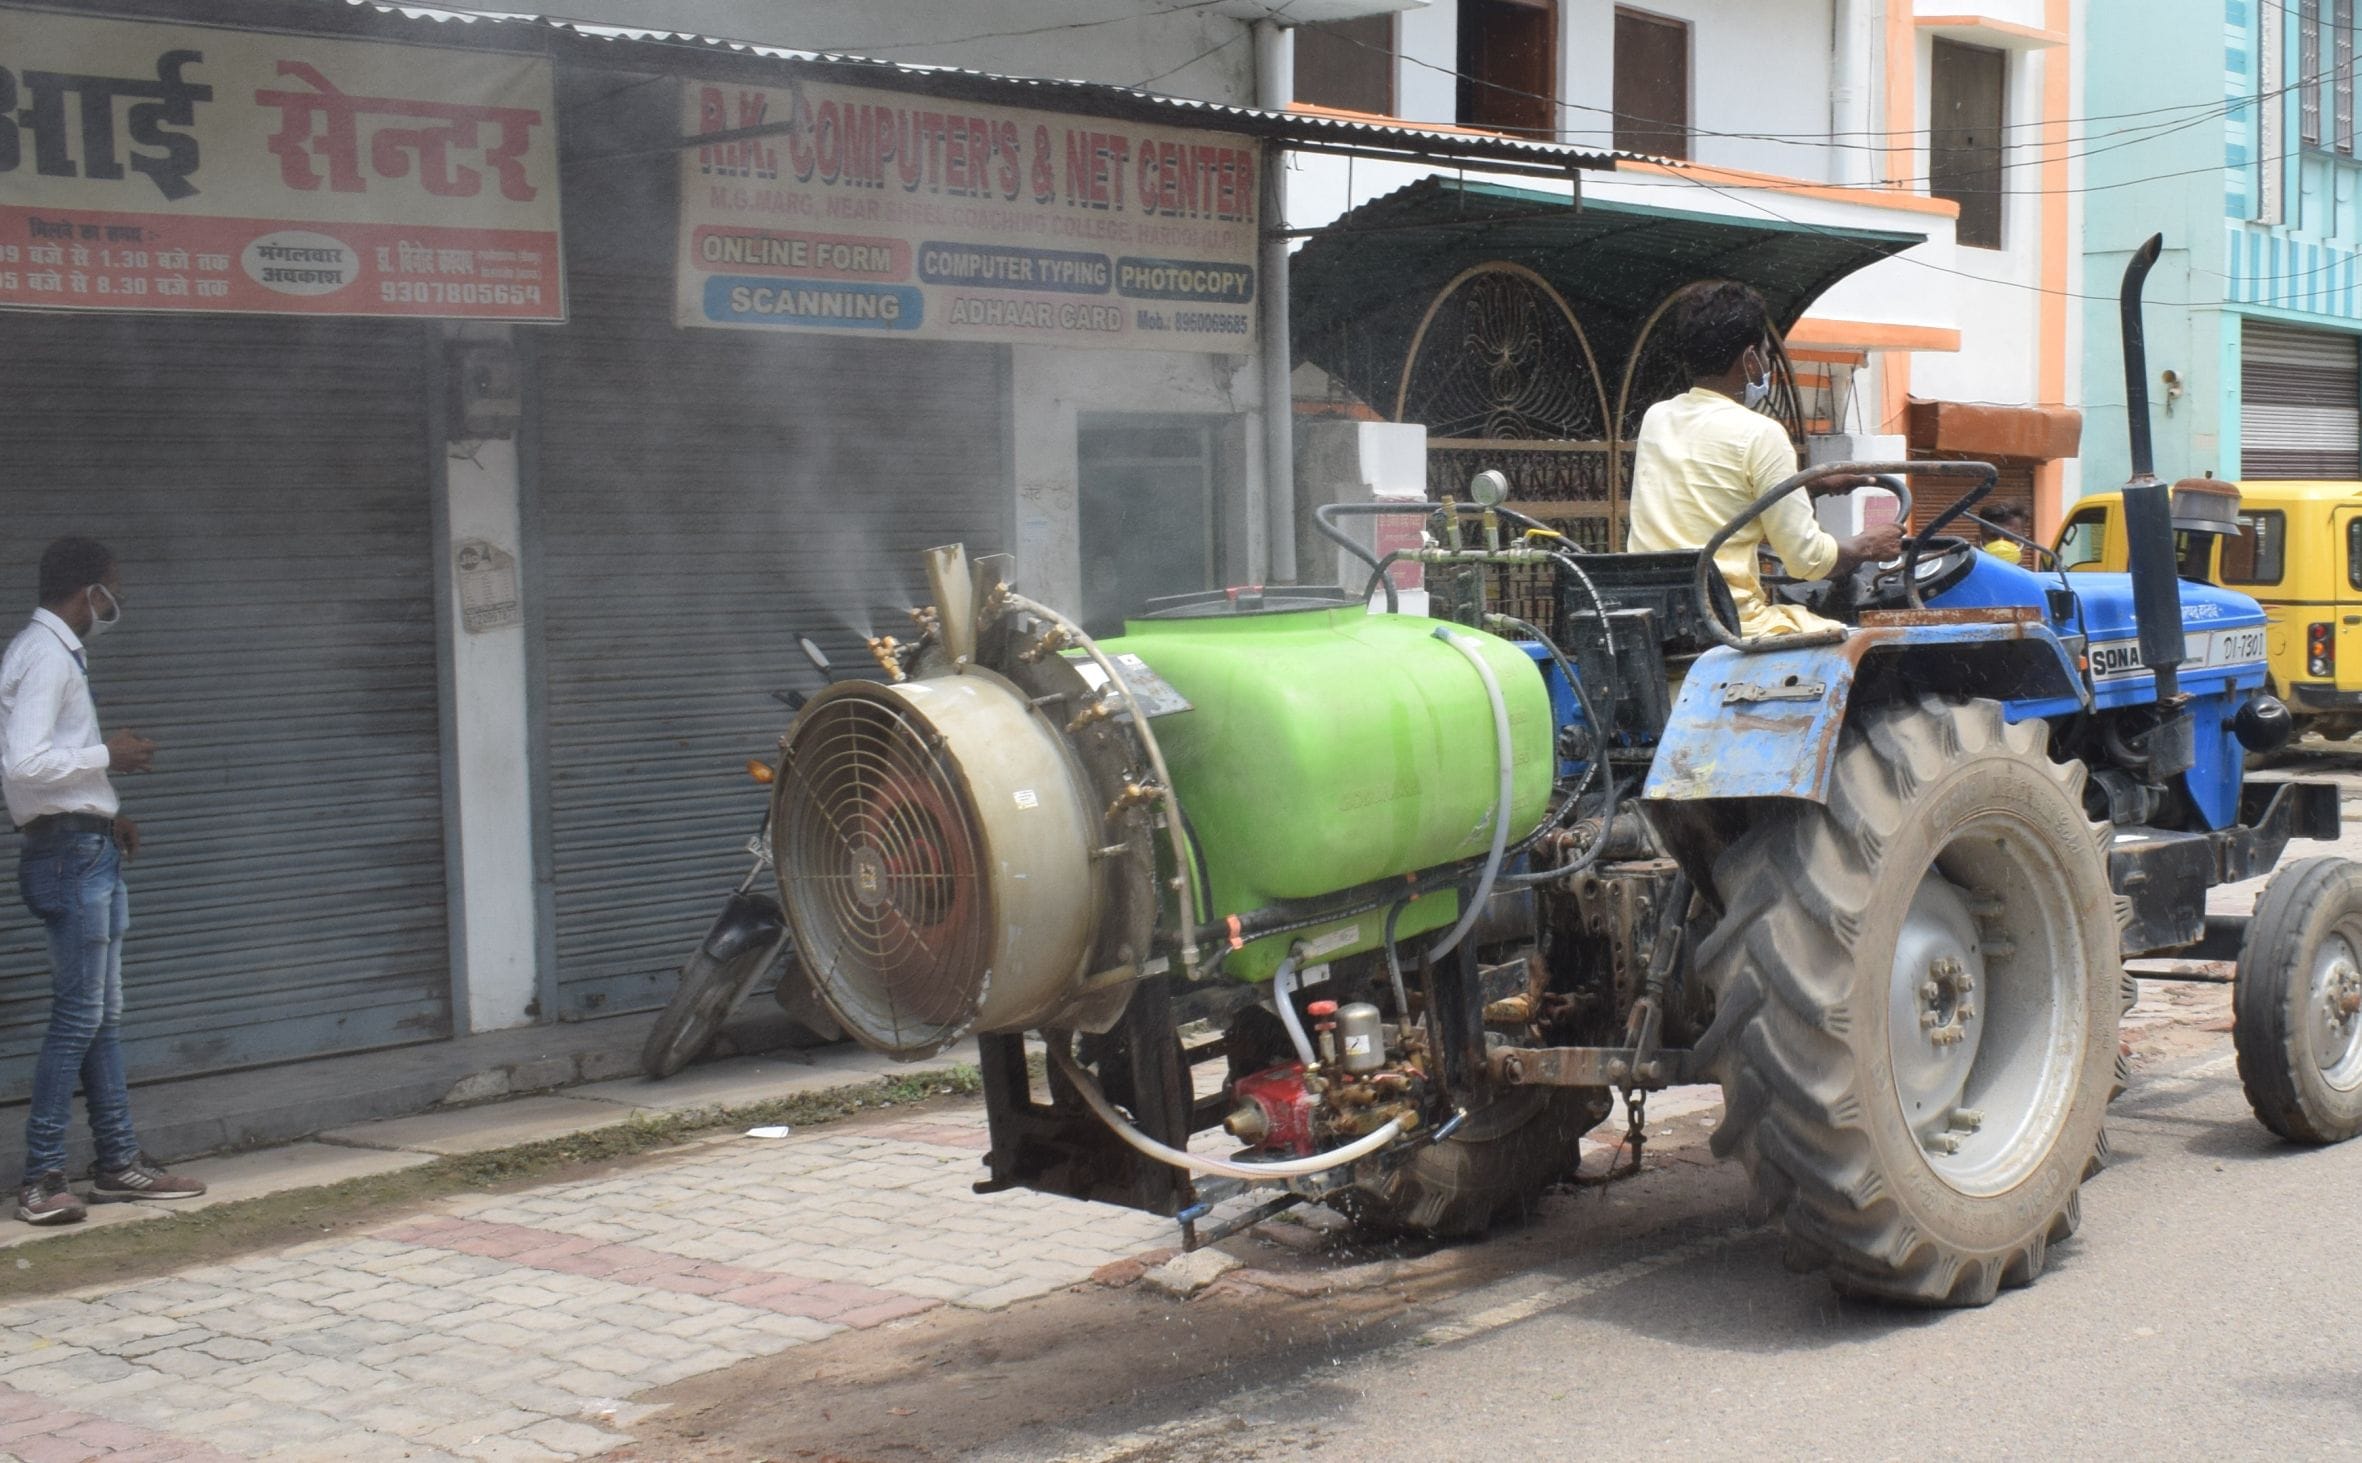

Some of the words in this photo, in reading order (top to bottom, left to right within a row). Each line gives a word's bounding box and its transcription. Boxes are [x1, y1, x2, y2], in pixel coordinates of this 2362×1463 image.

[255, 60, 542, 202] सेन्टर
[700, 86, 778, 180] R.K.
[789, 95, 1021, 201] COMPUTER'S
[1031, 124, 1055, 204] &
[1066, 129, 1131, 211] NET
[1137, 138, 1256, 224] CENTER
[826, 195, 881, 222] NEAR
[27, 242, 63, 265] बजे
[69, 244, 89, 267] से
[101, 250, 149, 269] 1.30
[156, 248, 189, 270] बजे
[196, 254, 231, 272] तक
[257, 242, 342, 264] मंगलवार
[703, 235, 808, 268] ONLINE
[815, 244, 893, 273] FORM
[924, 250, 1033, 282] COMPUTER
[1038, 260, 1107, 286] TYPING
[0, 271, 19, 290] 5
[27, 269, 63, 292] बजे
[69, 270, 88, 293] से
[97, 275, 148, 295] 8.30
[156, 273, 189, 296] बजे
[195, 279, 230, 297] तक
[262, 267, 343, 285] अवकाश
[1120, 266, 1249, 295] PHOTOCOPY
[730, 286, 900, 320] SCANNING
[950, 298, 1056, 331] ADHAAR
[1060, 304, 1124, 333] CARD
[2092, 646, 2140, 676] SONA
